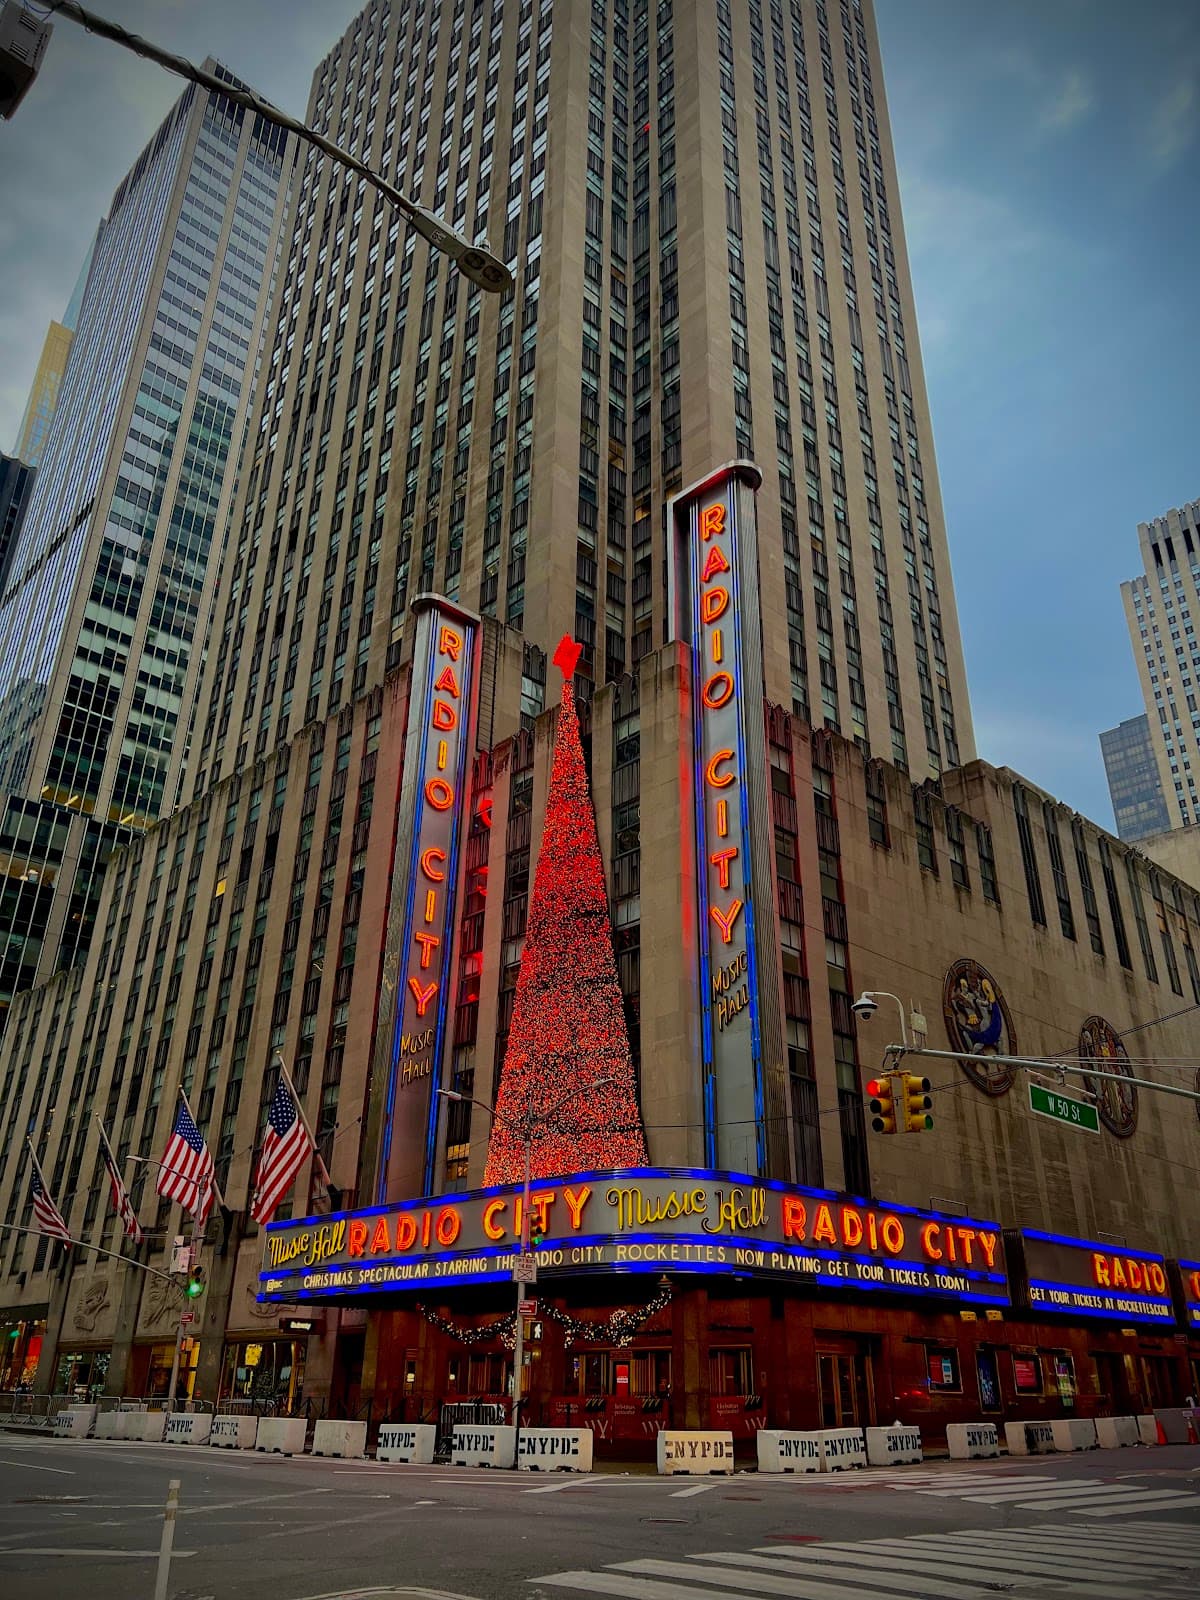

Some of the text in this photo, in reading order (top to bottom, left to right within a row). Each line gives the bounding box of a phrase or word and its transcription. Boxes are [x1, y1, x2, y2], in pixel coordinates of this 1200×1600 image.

[700, 503, 744, 944] RADIO CITY
[408, 625, 461, 1016] RADIO CITY
[1047, 1095, 1081, 1121] W 50 St
[267, 1186, 997, 1268] Music Hall RADIO CITY Music Hall RADIO CITY
[303, 1271, 353, 1289] CHRISTMAS
[358, 1263, 429, 1283] SPECTACULAR
[434, 1257, 487, 1276] STARRING
[496, 1254, 516, 1270] THE
[571, 1246, 604, 1264] CITY
[616, 1244, 726, 1261] ROCKETTES
[736, 1249, 765, 1267] NOW
[771, 1252, 822, 1273] PLAYING
[828, 1261, 849, 1276] GET
[856, 1264, 884, 1281] YOUR
[889, 1268, 930, 1287] TICKETS
[1091, 1252, 1166, 1294] RADIO
[1029, 1287, 1045, 1301] GET
[1048, 1290, 1070, 1304] YOUR
[1072, 1293, 1102, 1308] TICKETS
[1105, 1297, 1114, 1310] AT
[169, 1419, 190, 1433] NYPD
[382, 1432, 411, 1448] NYPD
[456, 1433, 490, 1452] NYPD
[526, 1437, 571, 1455] NYPD
[829, 1437, 860, 1457] NYPD
[892, 1434, 918, 1453] NYPD
[971, 1430, 995, 1446] NYPD
[674, 1440, 725, 1458] NYPD
[784, 1439, 815, 1458] NYPD
